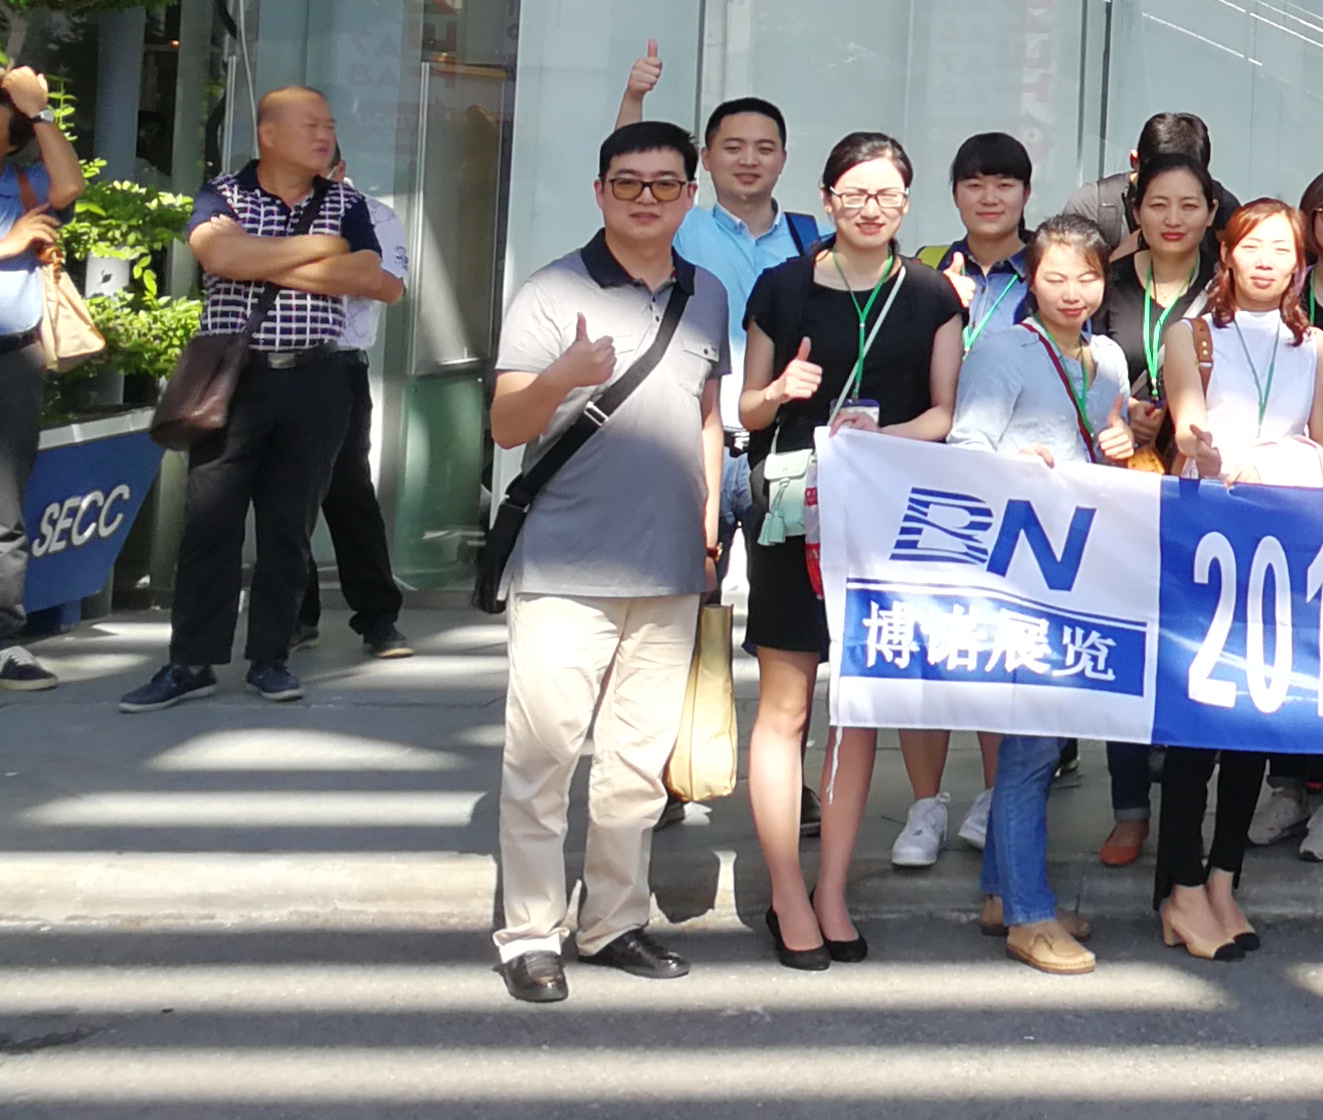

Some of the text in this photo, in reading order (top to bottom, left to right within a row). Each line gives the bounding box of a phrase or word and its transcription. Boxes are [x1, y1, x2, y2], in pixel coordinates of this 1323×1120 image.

[32, 483, 131, 558] SECC
[861, 599, 1118, 683] 博诺展览
